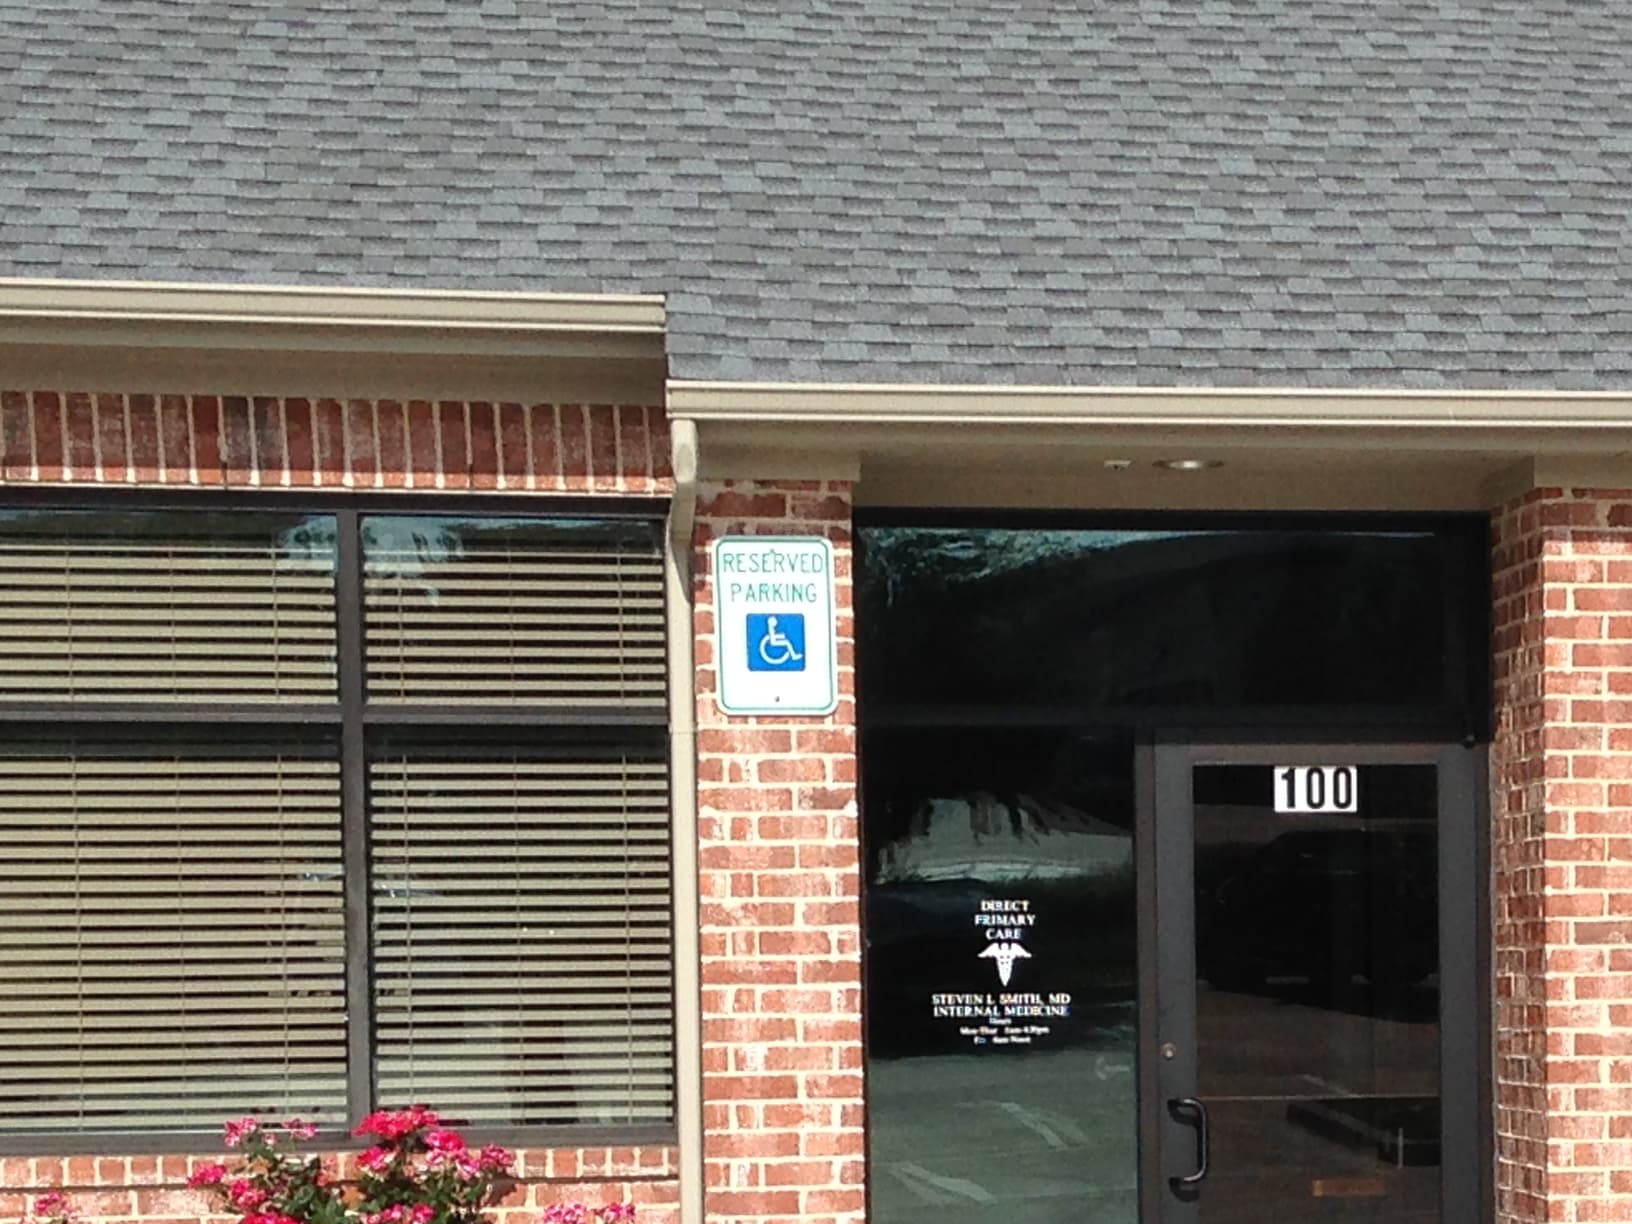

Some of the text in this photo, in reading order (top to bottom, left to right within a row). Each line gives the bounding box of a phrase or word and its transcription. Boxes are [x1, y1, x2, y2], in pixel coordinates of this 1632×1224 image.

[723, 552, 824, 573] RESERVED
[730, 583, 818, 604] PARKING
[1280, 766, 1352, 810] 100
[980, 900, 1030, 912] DIRECT
[974, 914, 1036, 926] PRIMARY
[985, 928, 1023, 939] CARE
[931, 993, 984, 1005] STEVEN
[1048, 993, 1071, 1005] MD
[933, 1005, 1070, 1017] INTERNAL MEDICINE
